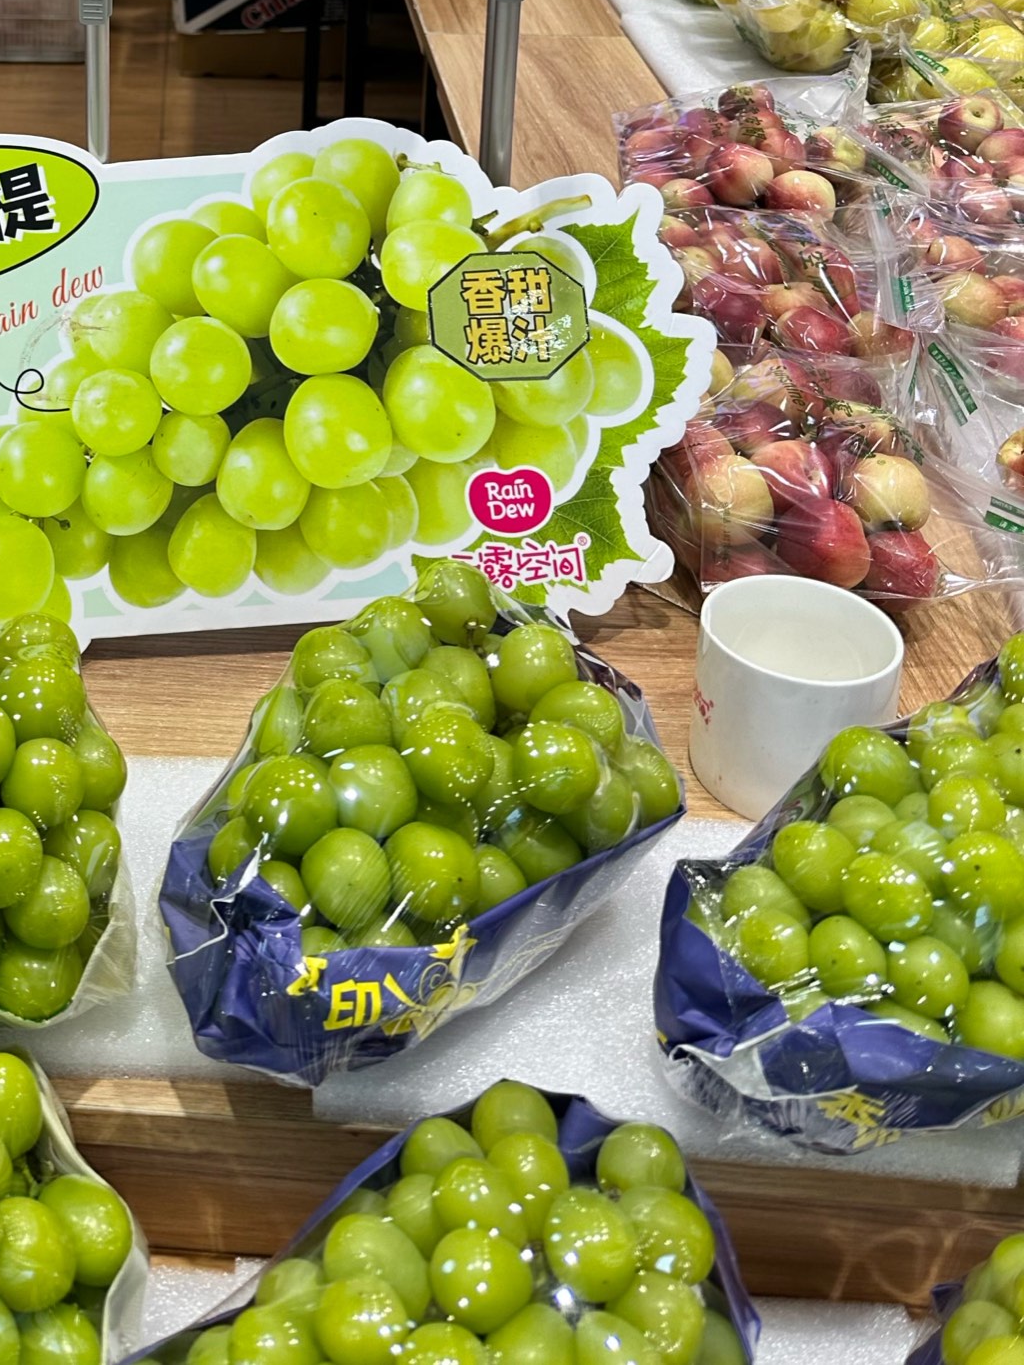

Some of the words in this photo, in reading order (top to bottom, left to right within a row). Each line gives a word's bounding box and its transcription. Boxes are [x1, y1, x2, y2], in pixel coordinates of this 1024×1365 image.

[52, 265, 103, 308] dew
[460, 267, 552, 317] 香甜
[466, 315, 559, 365] 爆汁
[484, 478, 535, 501] Rain
[487, 499, 536, 521] Dew
[451, 538, 586, 590] 露空间
